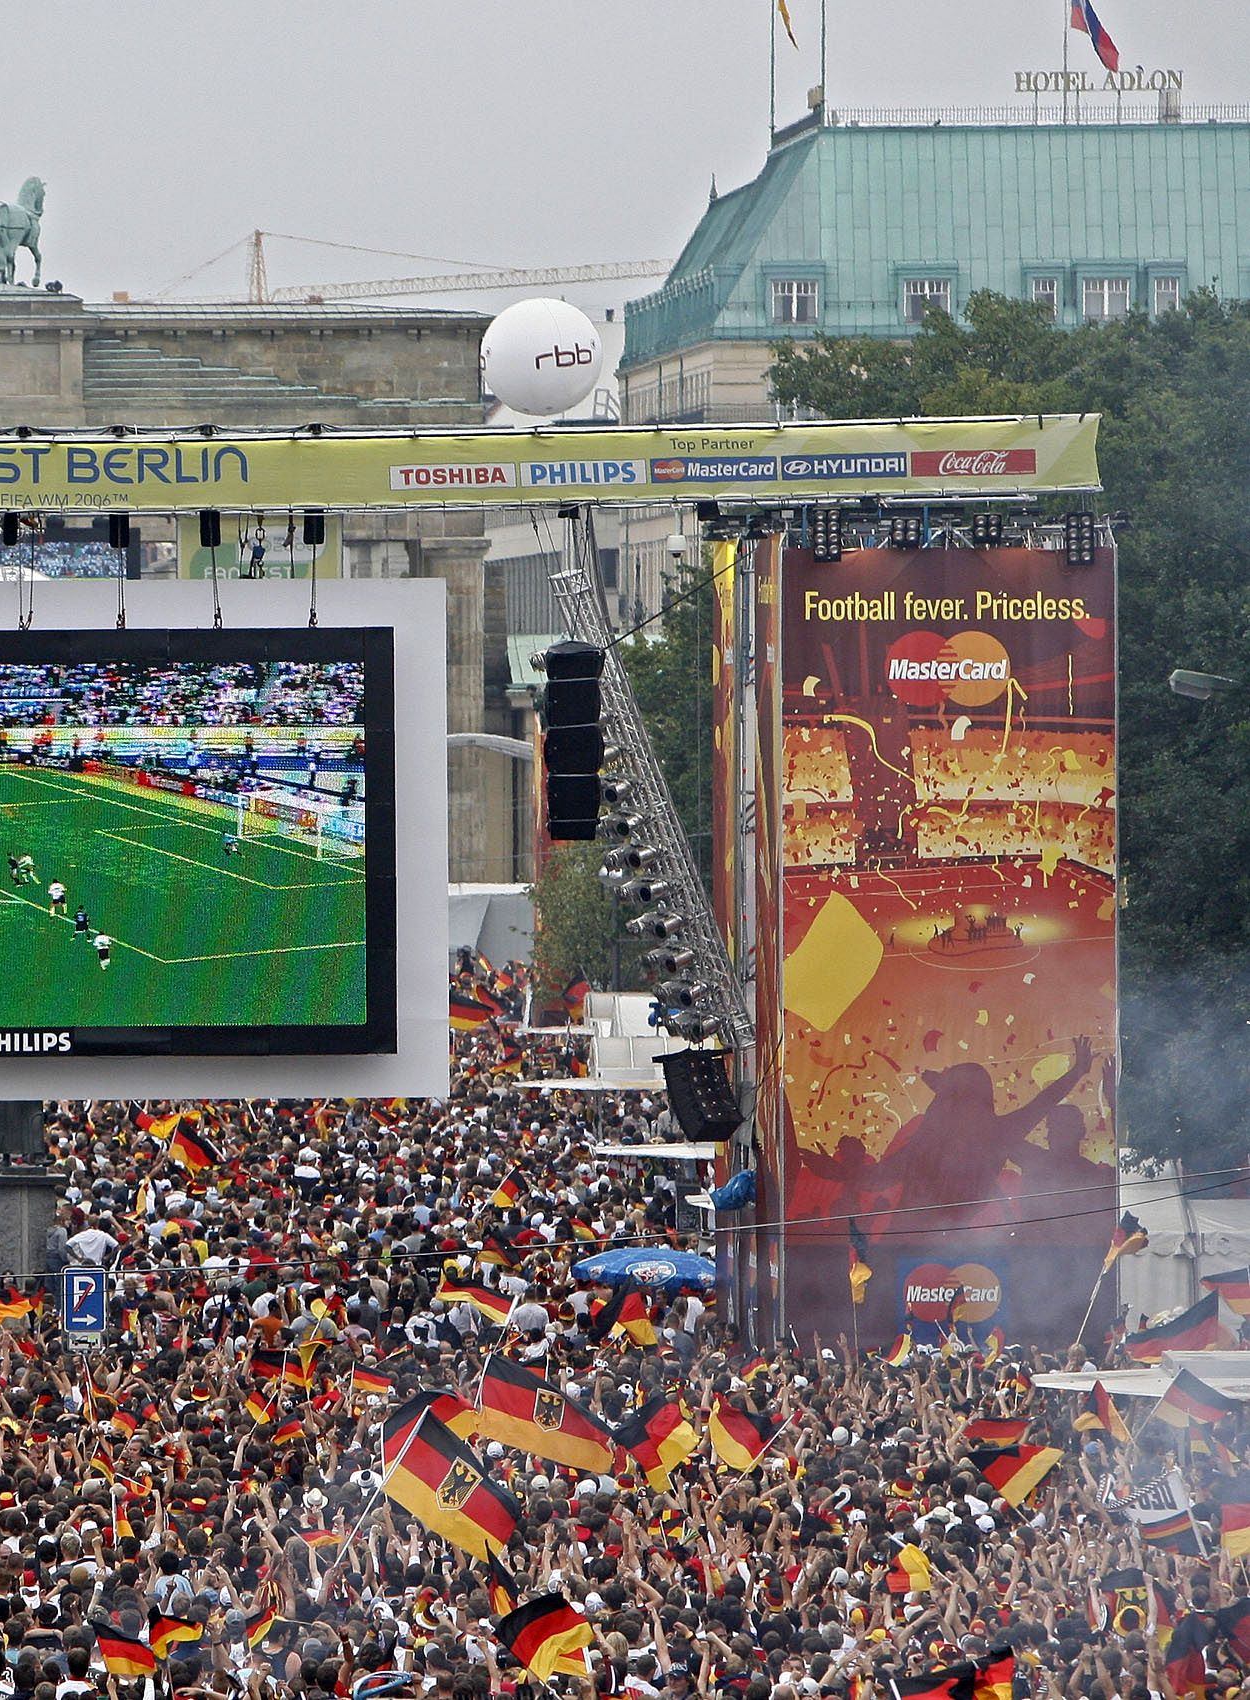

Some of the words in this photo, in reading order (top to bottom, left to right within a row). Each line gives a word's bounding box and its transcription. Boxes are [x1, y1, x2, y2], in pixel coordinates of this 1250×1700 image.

[1014, 71, 1094, 92] HOTEL
[1102, 70, 1184, 92] ADLON
[535, 342, 592, 370] rbb
[669, 438, 696, 452] Top
[701, 437, 754, 451] Partner
[67, 446, 249, 484] BERLIN
[530, 462, 637, 485] PHILIPS
[687, 461, 775, 478] MasterCard
[813, 457, 905, 475] HYUNDAI
[399, 467, 507, 486] TOSHIBA
[0, 493, 34, 508] FIFA
[38, 493, 69, 507] WM
[804, 591, 896, 621] Football
[903, 591, 969, 621] fever.
[975, 591, 1091, 621] Priceless.
[888, 659, 1007, 681] MasterCard
[73, 1276, 96, 1310] P
[906, 1284, 999, 1303] MasteCard
